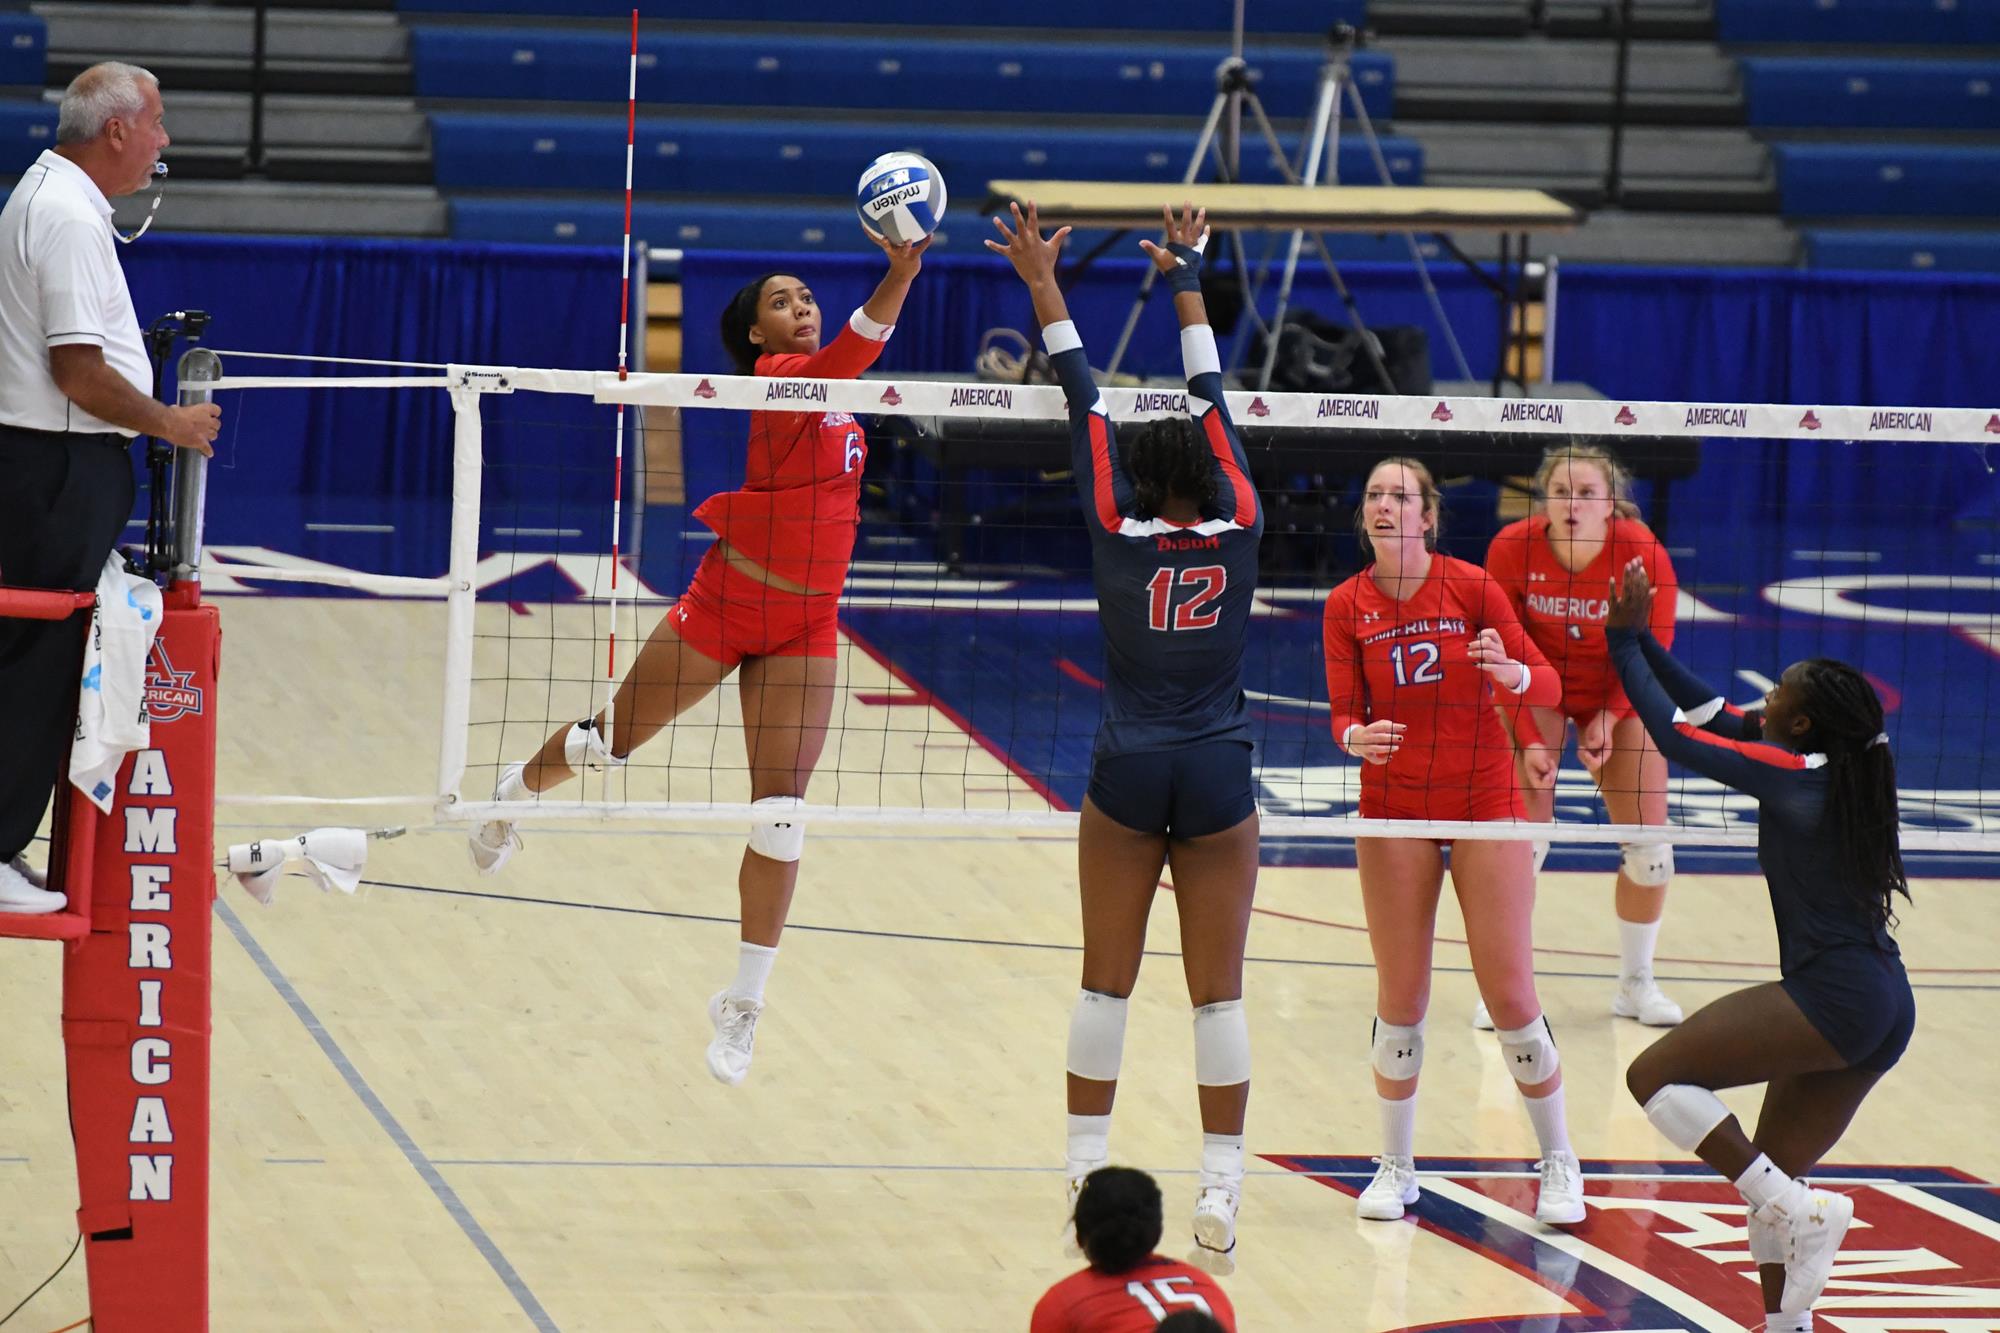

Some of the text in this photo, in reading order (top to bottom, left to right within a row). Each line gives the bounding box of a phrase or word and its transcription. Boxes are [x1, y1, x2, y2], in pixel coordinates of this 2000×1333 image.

[872, 185, 921, 211] molten
[765, 382, 828, 402] AMERICAN
[950, 388, 1012, 410] AMERICAN
[1134, 393, 1190, 413] AMERICA
[1317, 399, 1379, 420] AMERICAN
[1500, 403, 1562, 424] AMERICAN
[1685, 408, 1747, 428] AMERICAN
[1869, 412, 1931, 432] AMERICAN
[845, 432, 863, 473] 6
[1146, 565, 1227, 631] 12
[1527, 593, 1609, 620] AMERICA
[1391, 641, 1443, 685] 12
[148, 690, 195, 705] RICAN
[123, 748, 177, 1201] AMERICAN
[1126, 1275, 1213, 1323] 15
